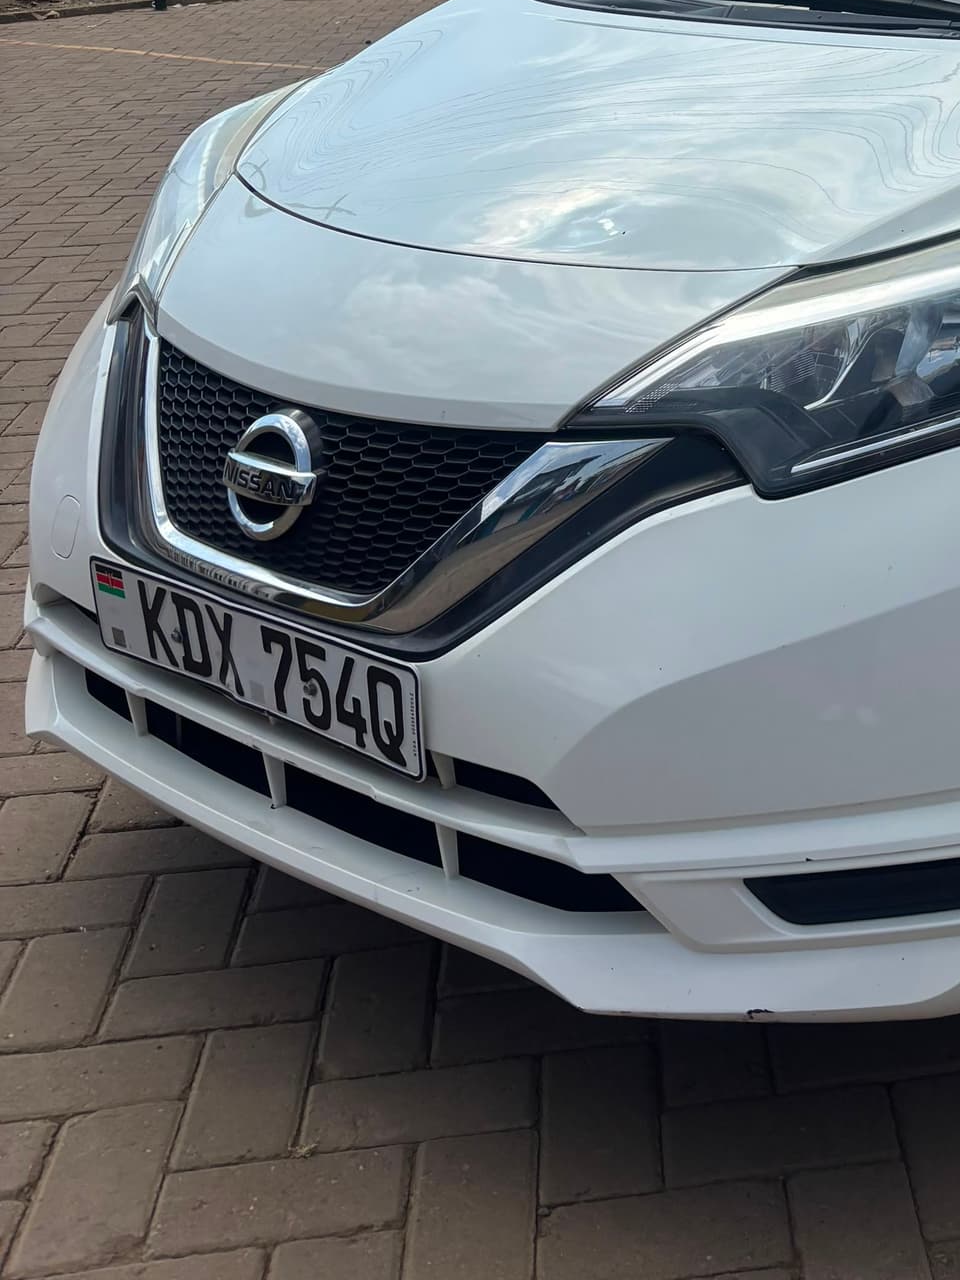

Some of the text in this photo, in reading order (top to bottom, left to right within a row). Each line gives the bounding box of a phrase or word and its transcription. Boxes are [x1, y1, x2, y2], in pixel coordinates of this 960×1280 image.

[223, 460, 302, 504] NISSAN
[137, 580, 245, 696] KDX
[260, 625, 407, 767] 754Q
